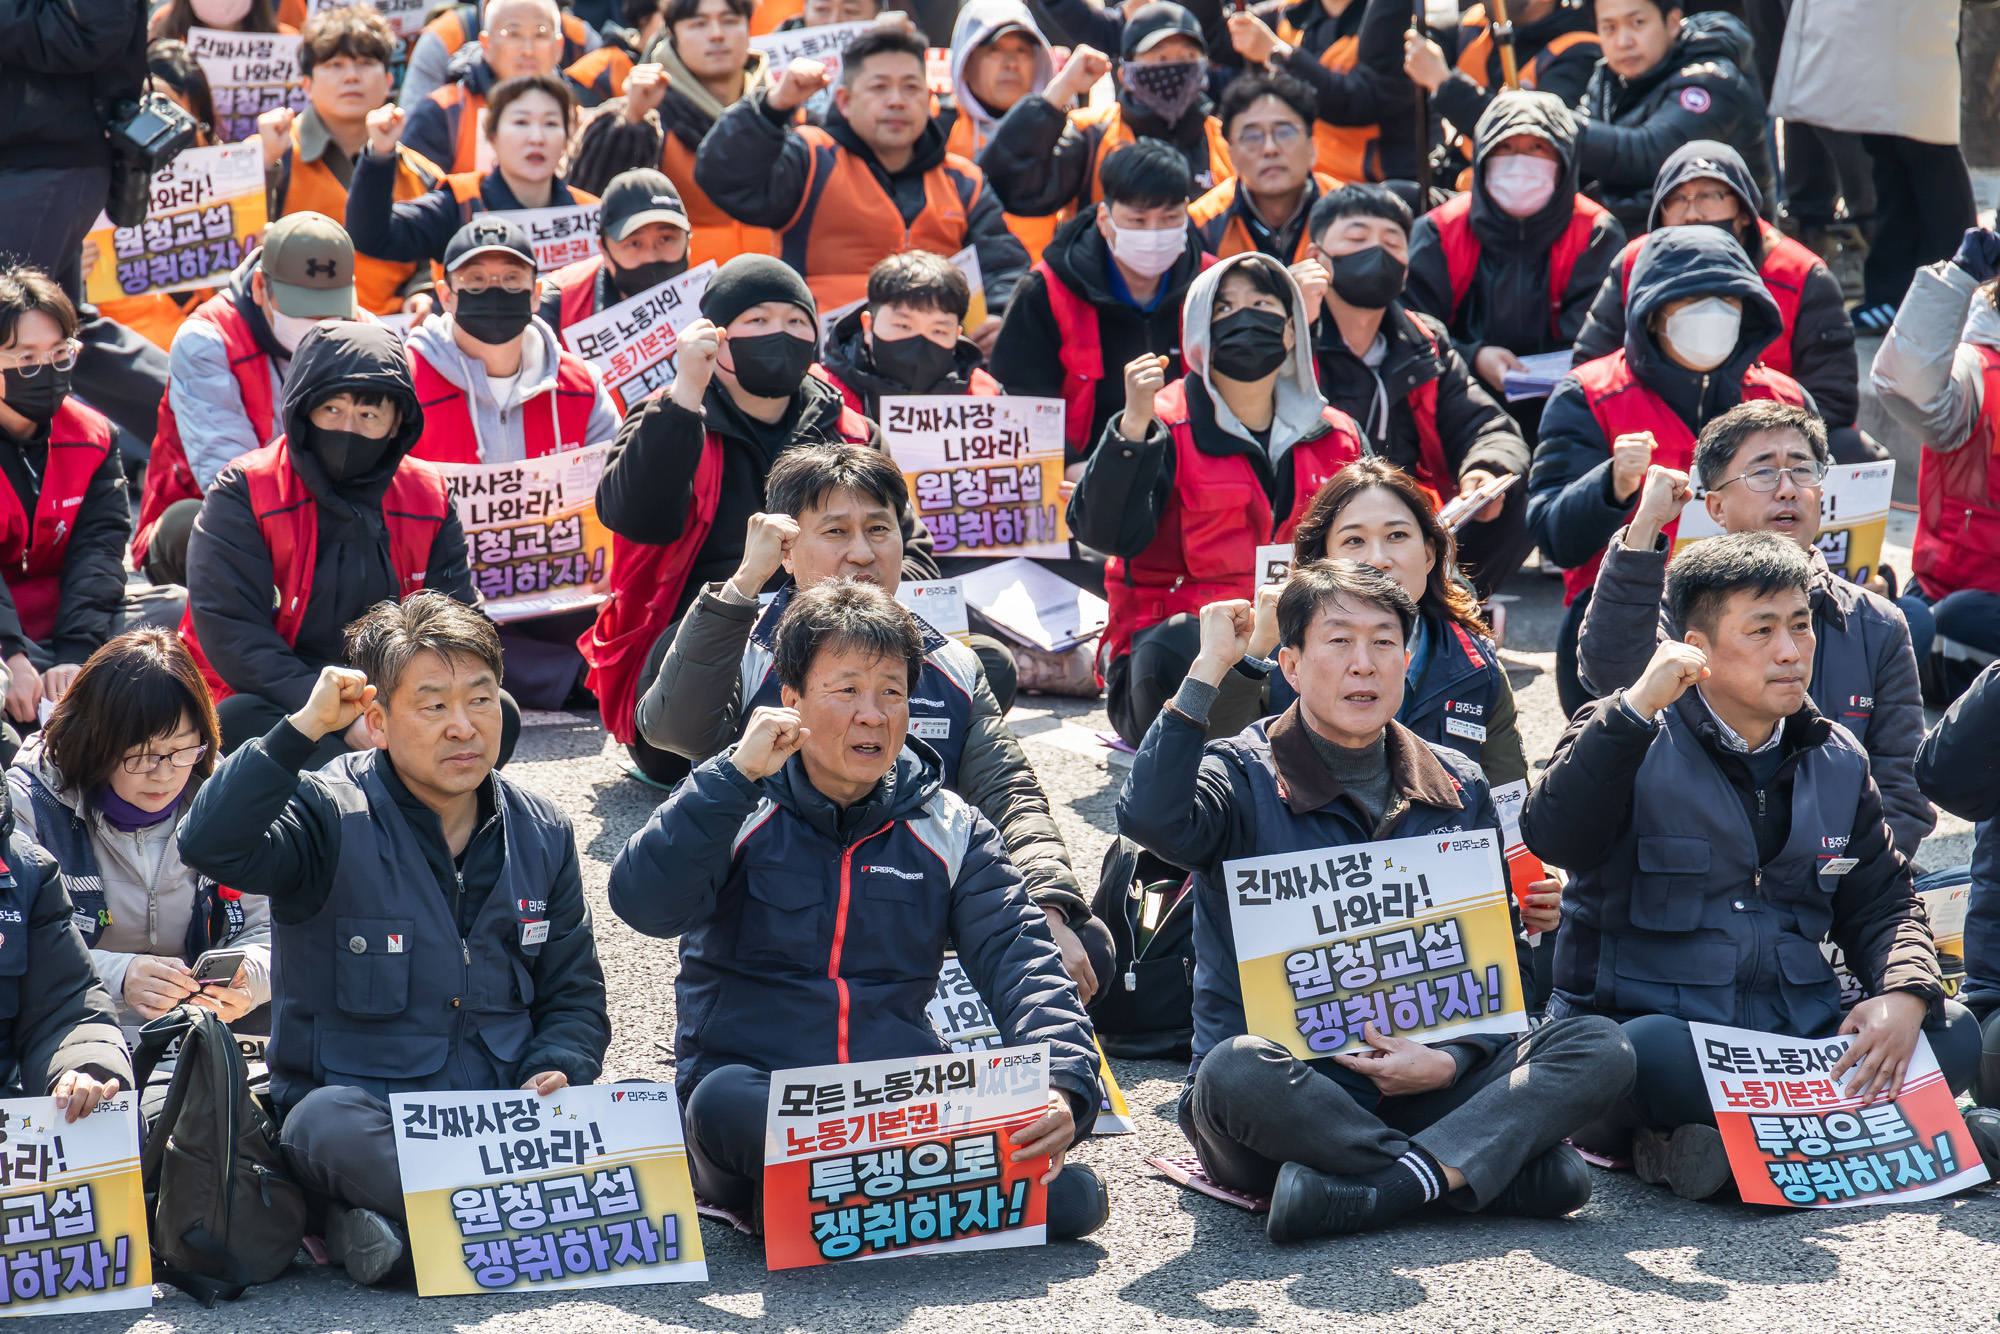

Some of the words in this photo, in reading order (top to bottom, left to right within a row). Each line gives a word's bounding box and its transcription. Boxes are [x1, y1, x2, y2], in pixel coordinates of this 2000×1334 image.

[232, 60, 293, 81] 나와라
[113, 204, 232, 259] 원청교섭
[533, 238, 590, 264] 기본권
[577, 327, 618, 360] 모든
[616, 286, 682, 340] 노동자의
[889, 404, 995, 434] 진짜사장
[944, 427, 1030, 463] 나와라!
[447, 469, 524, 498] 짜사장
[471, 483, 563, 525] 나와라!
[915, 463, 1042, 511] 원청교섭
[920, 505, 1056, 552] 쟁취하자!
[472, 547, 605, 599] 취하자!
[1455, 702, 1484, 716] 민주노총
[1494, 790, 1521, 804] 주노총
[1452, 838, 1490, 851] 민주노총
[1236, 851, 1372, 906] 진짜사장
[1312, 873, 1433, 935] 나와라!
[1284, 917, 1467, 1001] 원청교섭
[1295, 964, 1503, 1052] 쟁취하자!
[1003, 1052, 1041, 1068] 민주노총
[1704, 1038, 1756, 1074] 모든
[627, 1091, 668, 1102] 민주노총
[778, 1083, 846, 1117] 모든
[853, 1059, 976, 1109] 노동자의
[1720, 1078, 1840, 1108] 노동기본권
[402, 1099, 541, 1140] 진짜사장
[787, 1102, 939, 1157] 노동기본권
[1749, 1101, 1916, 1157] 투쟁으로
[478, 1122, 606, 1175] 나와라!
[809, 1132, 1000, 1206] 투쟁으로
[1766, 1131, 1957, 1203] 쟁취하자!
[0, 1184, 96, 1245] 교섭
[451, 1166, 641, 1237] 원청교섭
[811, 1178, 1029, 1260] 쟁취하자!
[0, 1235, 129, 1304] 하자!
[462, 1214, 679, 1288] 쟁취하자!
